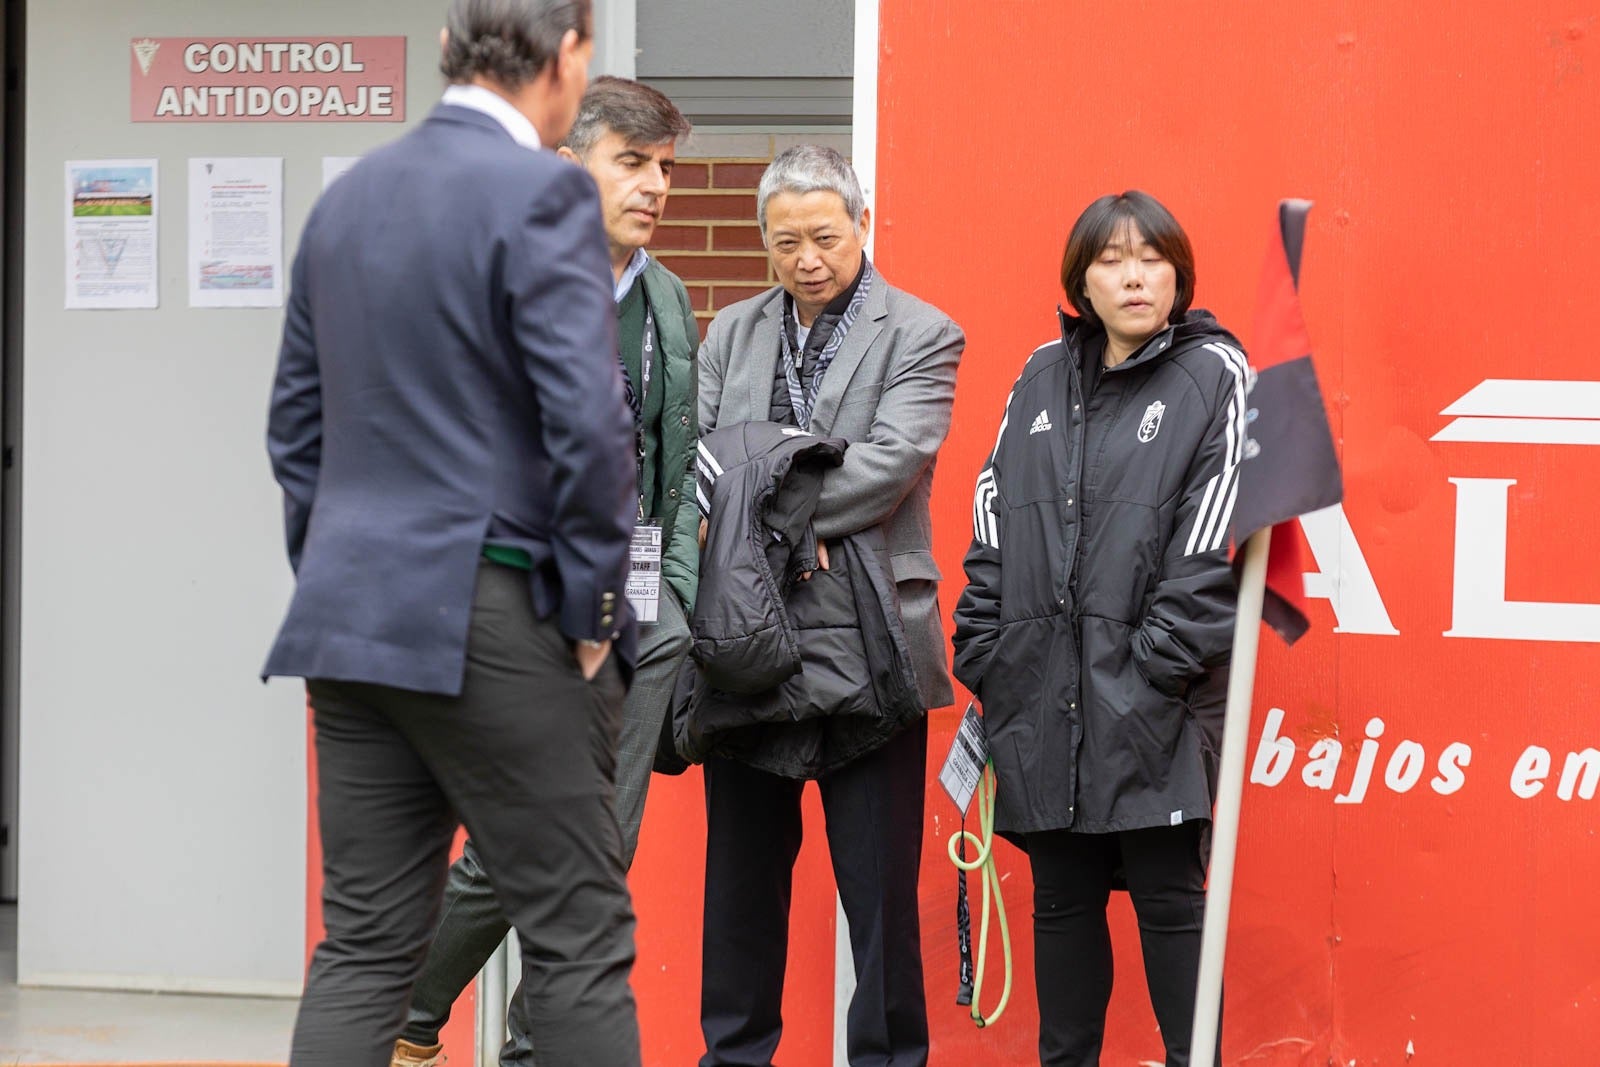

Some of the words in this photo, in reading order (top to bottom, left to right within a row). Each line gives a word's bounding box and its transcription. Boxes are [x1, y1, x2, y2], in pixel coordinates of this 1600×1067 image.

[183, 42, 364, 73] CONTROL
[155, 86, 393, 116] ANTIDOPAJE
[1029, 423, 1052, 435] adidas
[632, 562, 651, 571] STAFF
[625, 588, 649, 597] GRANADA
[650, 588, 657, 597] CF
[1250, 708, 1472, 804] bajos
[1510, 745, 1600, 801] en
